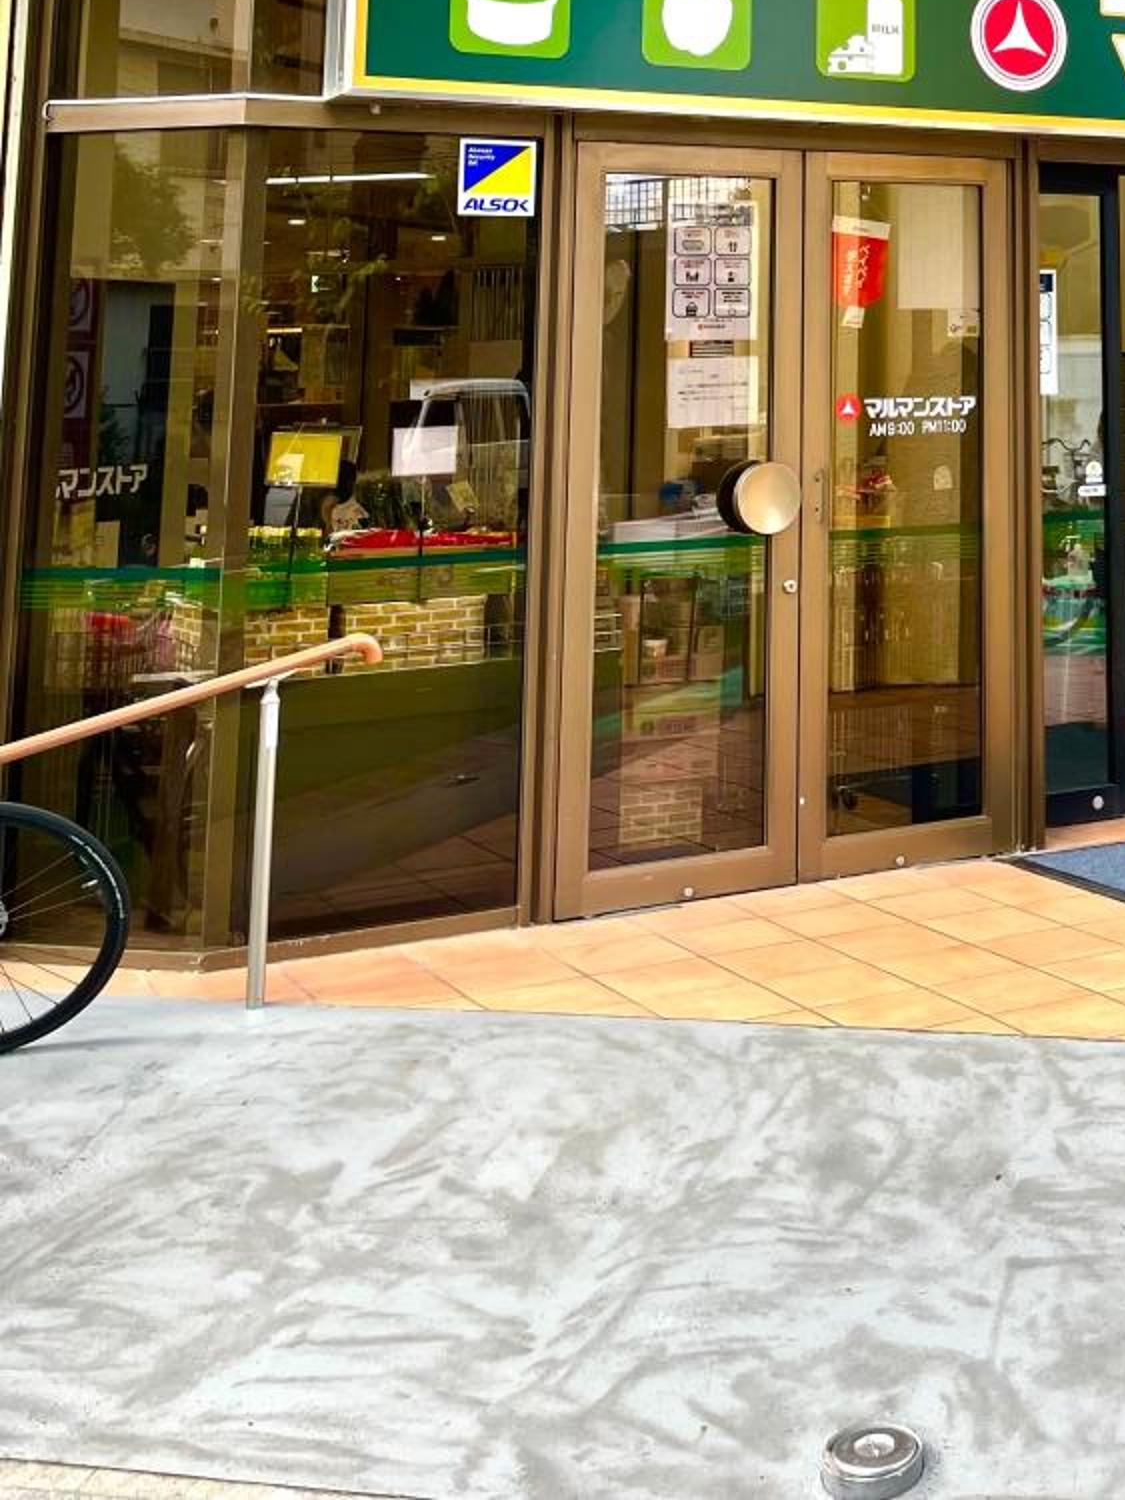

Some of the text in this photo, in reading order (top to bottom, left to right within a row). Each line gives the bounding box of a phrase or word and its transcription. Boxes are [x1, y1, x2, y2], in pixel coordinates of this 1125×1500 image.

[463, 197, 529, 213] ALSOK
[863, 396, 977, 419] マルマンストア
